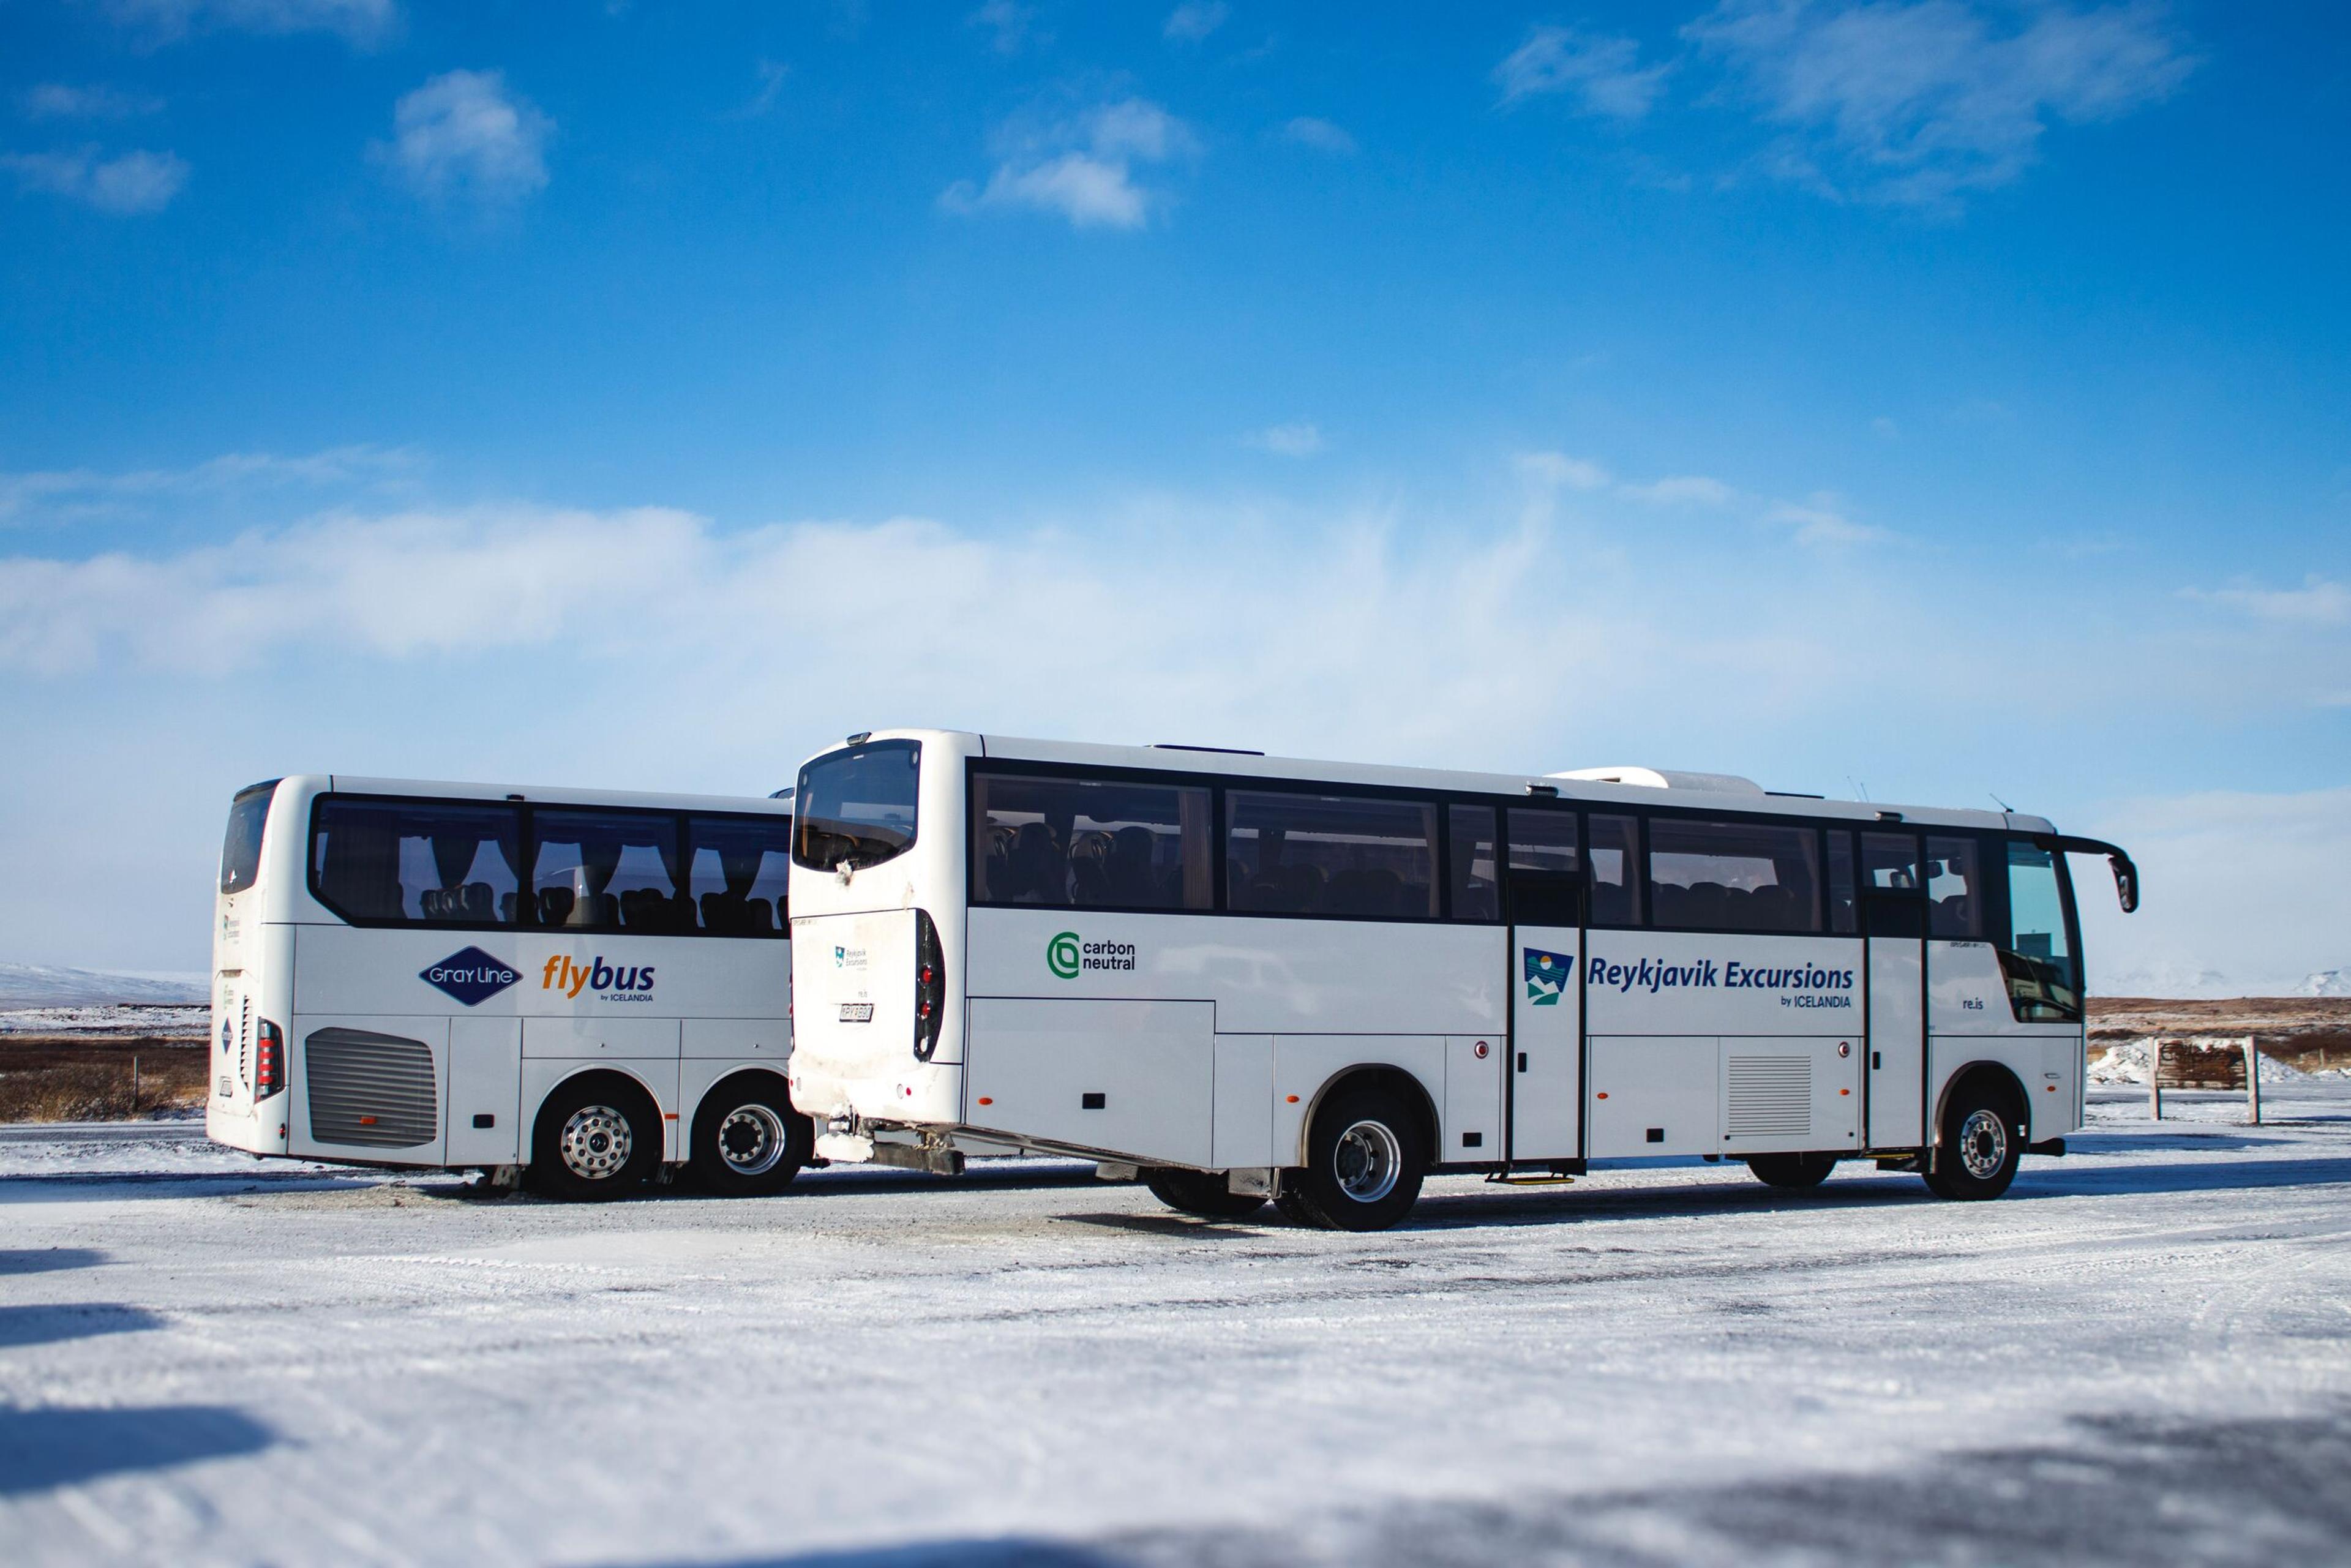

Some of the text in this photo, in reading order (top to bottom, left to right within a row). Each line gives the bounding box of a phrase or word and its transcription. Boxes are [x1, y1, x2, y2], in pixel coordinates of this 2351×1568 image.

[1083, 940, 1135, 955] carbon
[1083, 956, 1135, 970] neutral
[430, 967, 513, 983] Gray Line
[542, 955, 656, 999] flybus
[1588, 958, 1853, 993] Reykjavik Excursions
[1781, 996, 1851, 1008] by ICELANDIA
[1963, 997, 1984, 1010] re.is
